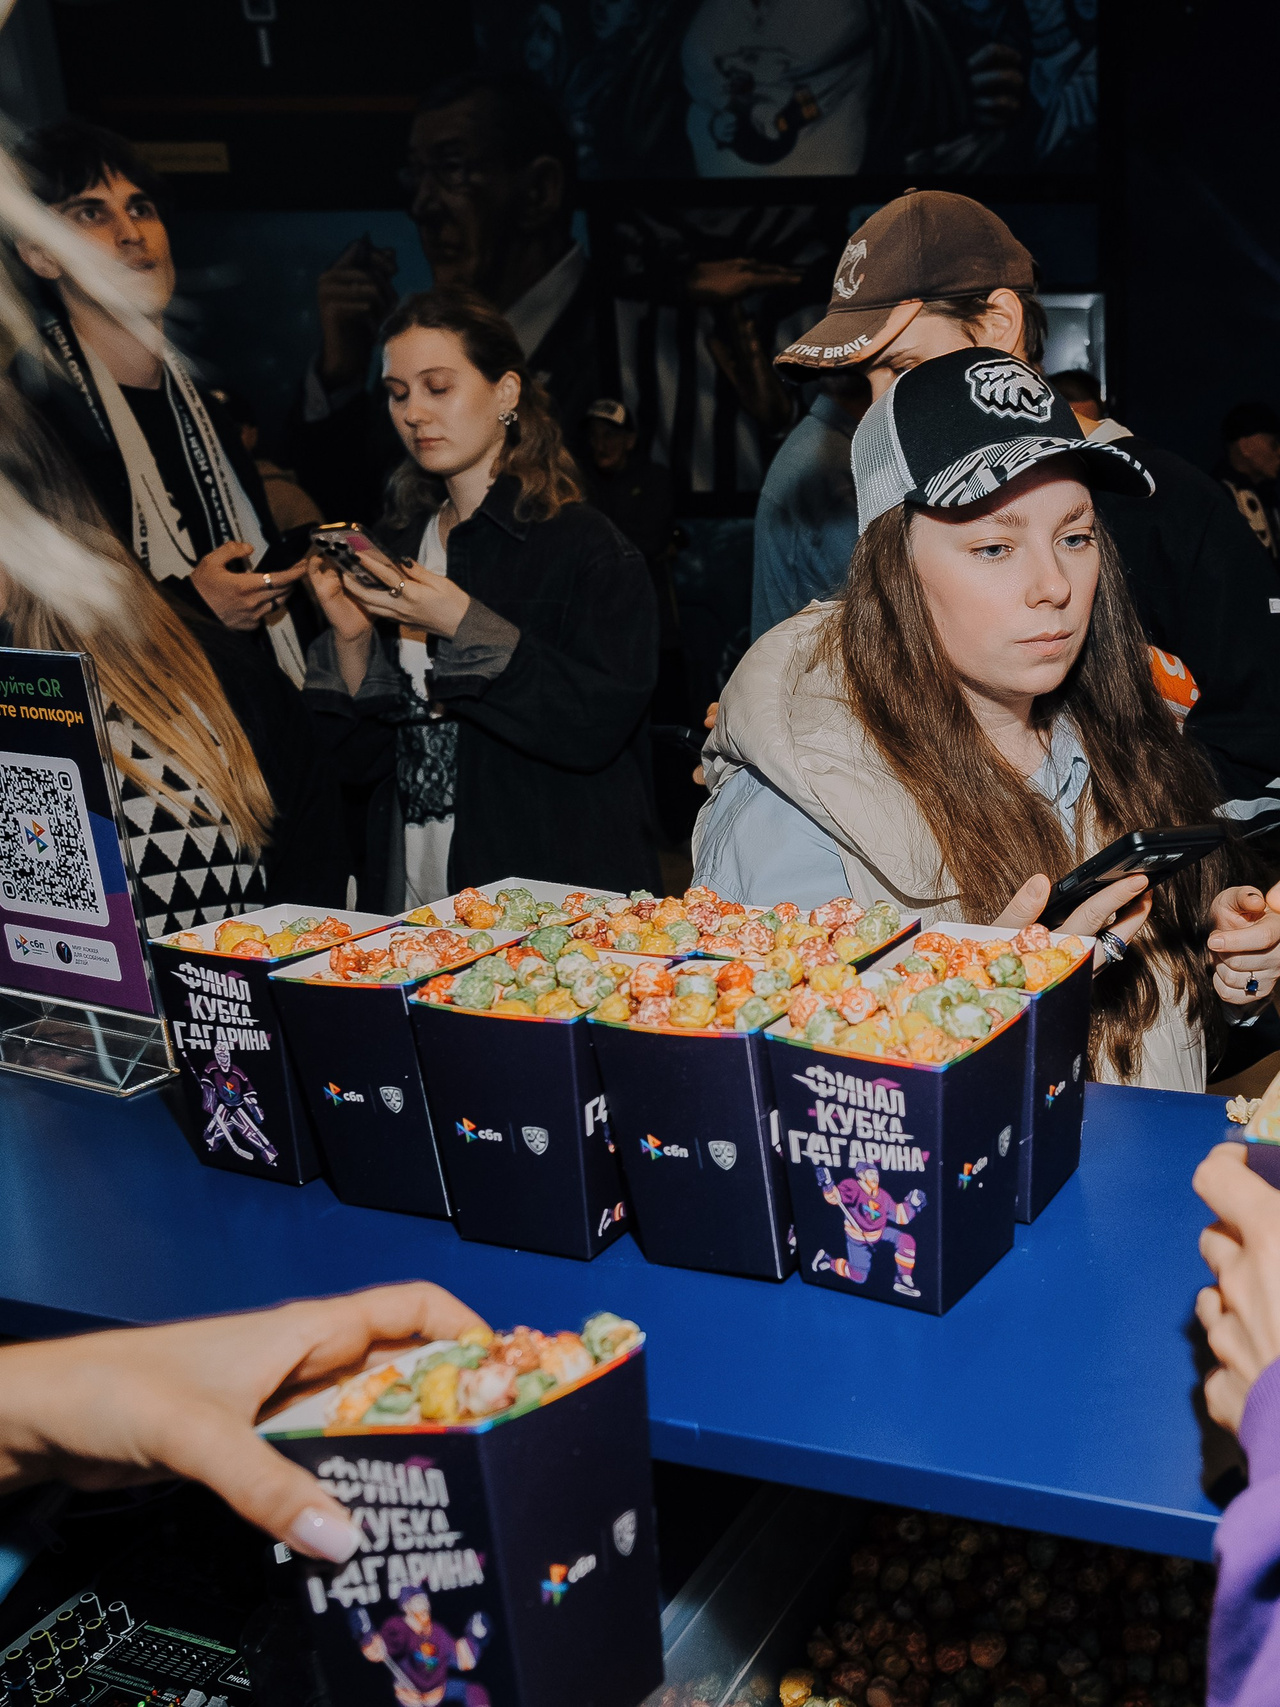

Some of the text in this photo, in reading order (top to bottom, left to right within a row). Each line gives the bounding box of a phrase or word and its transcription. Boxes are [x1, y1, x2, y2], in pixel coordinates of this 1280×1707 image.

[795, 344, 822, 357] THE
[823, 334, 873, 358] BRAVE
[0, 676, 63, 698] уйте QR
[0, 704, 84, 727] те попкорн
[30, 940, 45, 949] сбп
[170, 961, 252, 1002] ФИНАЛ
[188, 992, 259, 1026] КУБКА
[172, 1020, 271, 1051] ГАГАРИНА
[343, 1091, 364, 1103] сбп
[791, 1065, 906, 1117] ФИНАЛ
[478, 1128, 503, 1142] сбп
[815, 1099, 914, 1144] КУБКА
[663, 1144, 689, 1158] сбп
[788, 1129, 925, 1172] ГАГАРИНА
[317, 1455, 450, 1508] ФИНАЛ
